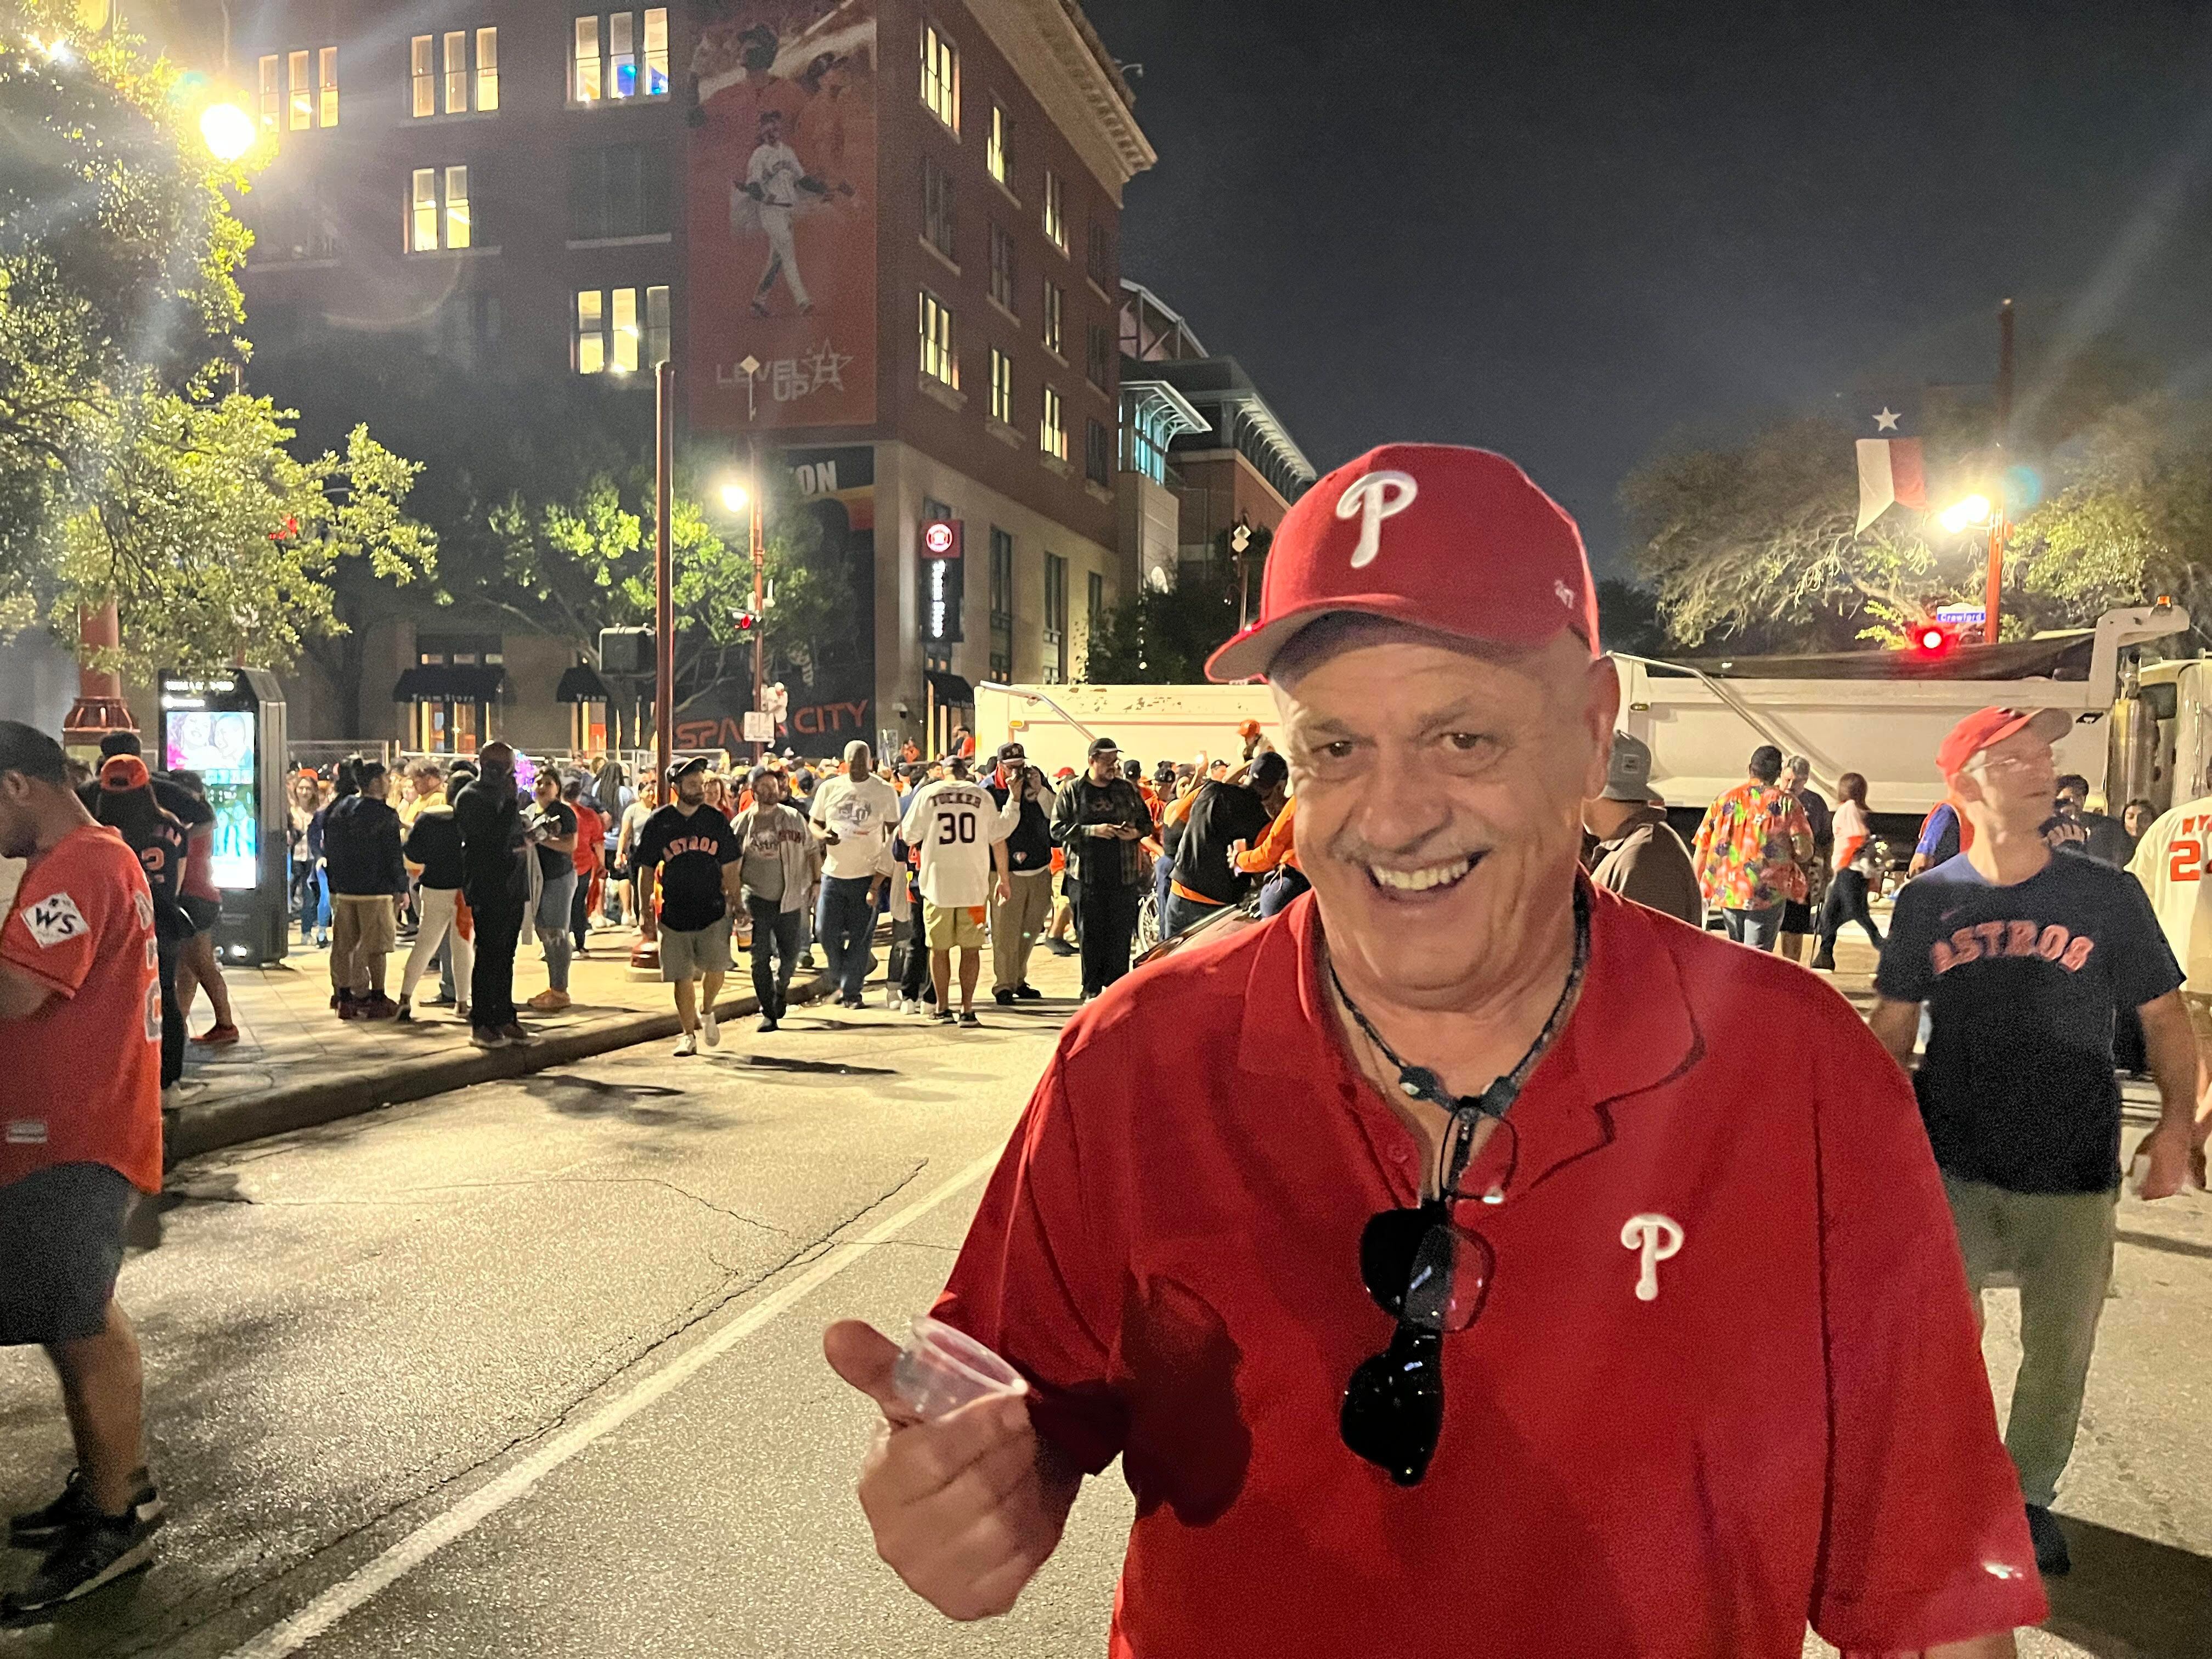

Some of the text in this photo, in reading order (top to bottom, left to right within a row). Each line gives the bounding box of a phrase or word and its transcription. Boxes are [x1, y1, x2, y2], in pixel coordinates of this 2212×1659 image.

[773, 380, 810, 402] UP
[1336, 471, 1418, 569] P
[1940, 613, 1982, 622] Crawford
[794, 699, 869, 734] CITY
[937, 812, 976, 845] 30
[36, 907, 76, 934] WS
[1931, 920, 2095, 974] ASTROS
[1620, 1213, 1685, 1301] P
